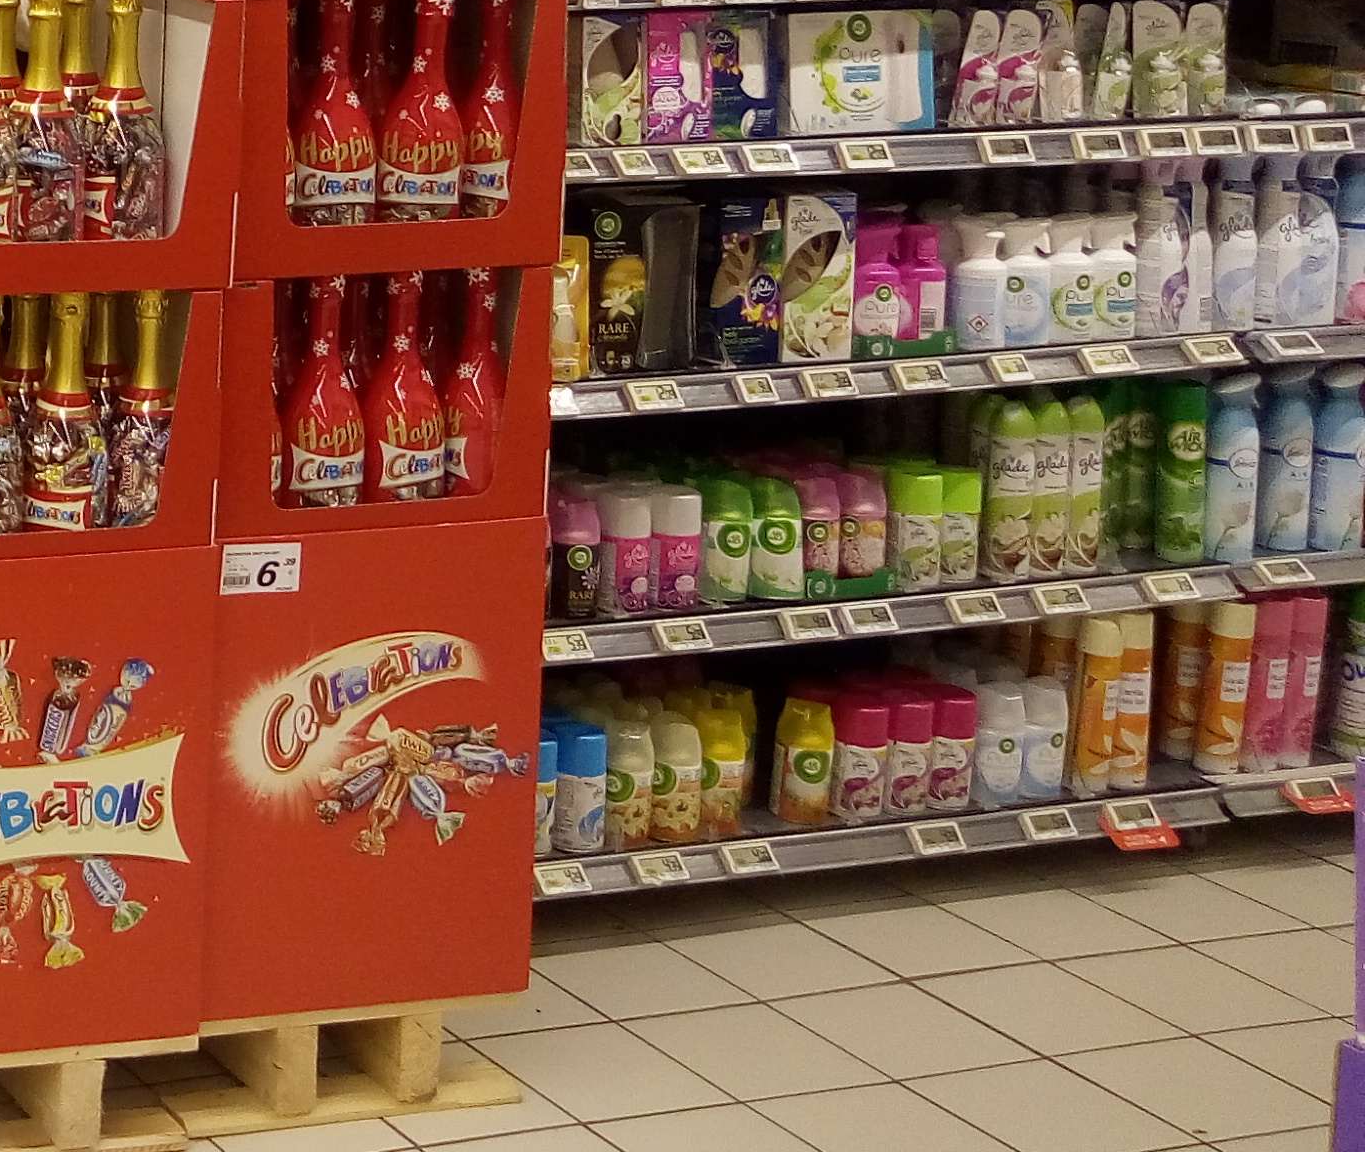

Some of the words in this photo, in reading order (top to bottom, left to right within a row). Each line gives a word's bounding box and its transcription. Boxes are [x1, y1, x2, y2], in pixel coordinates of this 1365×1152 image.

[381, 130, 460, 174] Happy
[597, 321, 631, 335] RARE
[992, 459, 1030, 480] glade
[256, 560, 281, 587] 6
[282, 557, 296, 567] 39
